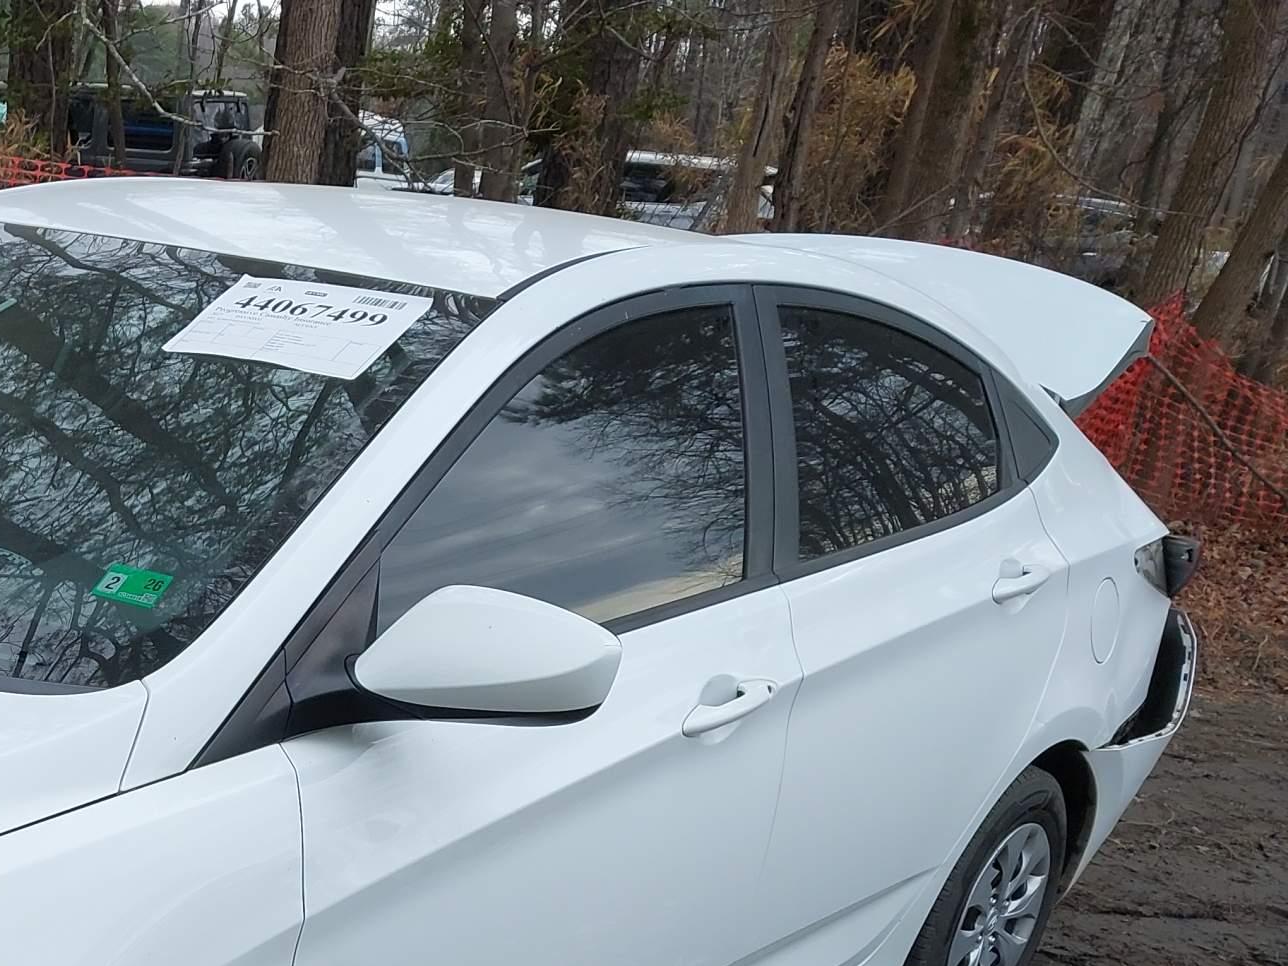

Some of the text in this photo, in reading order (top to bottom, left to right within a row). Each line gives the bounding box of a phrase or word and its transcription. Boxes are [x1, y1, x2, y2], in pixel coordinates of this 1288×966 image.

[234, 295, 388, 327] 44067499
[105, 576, 165, 592] 2 26
